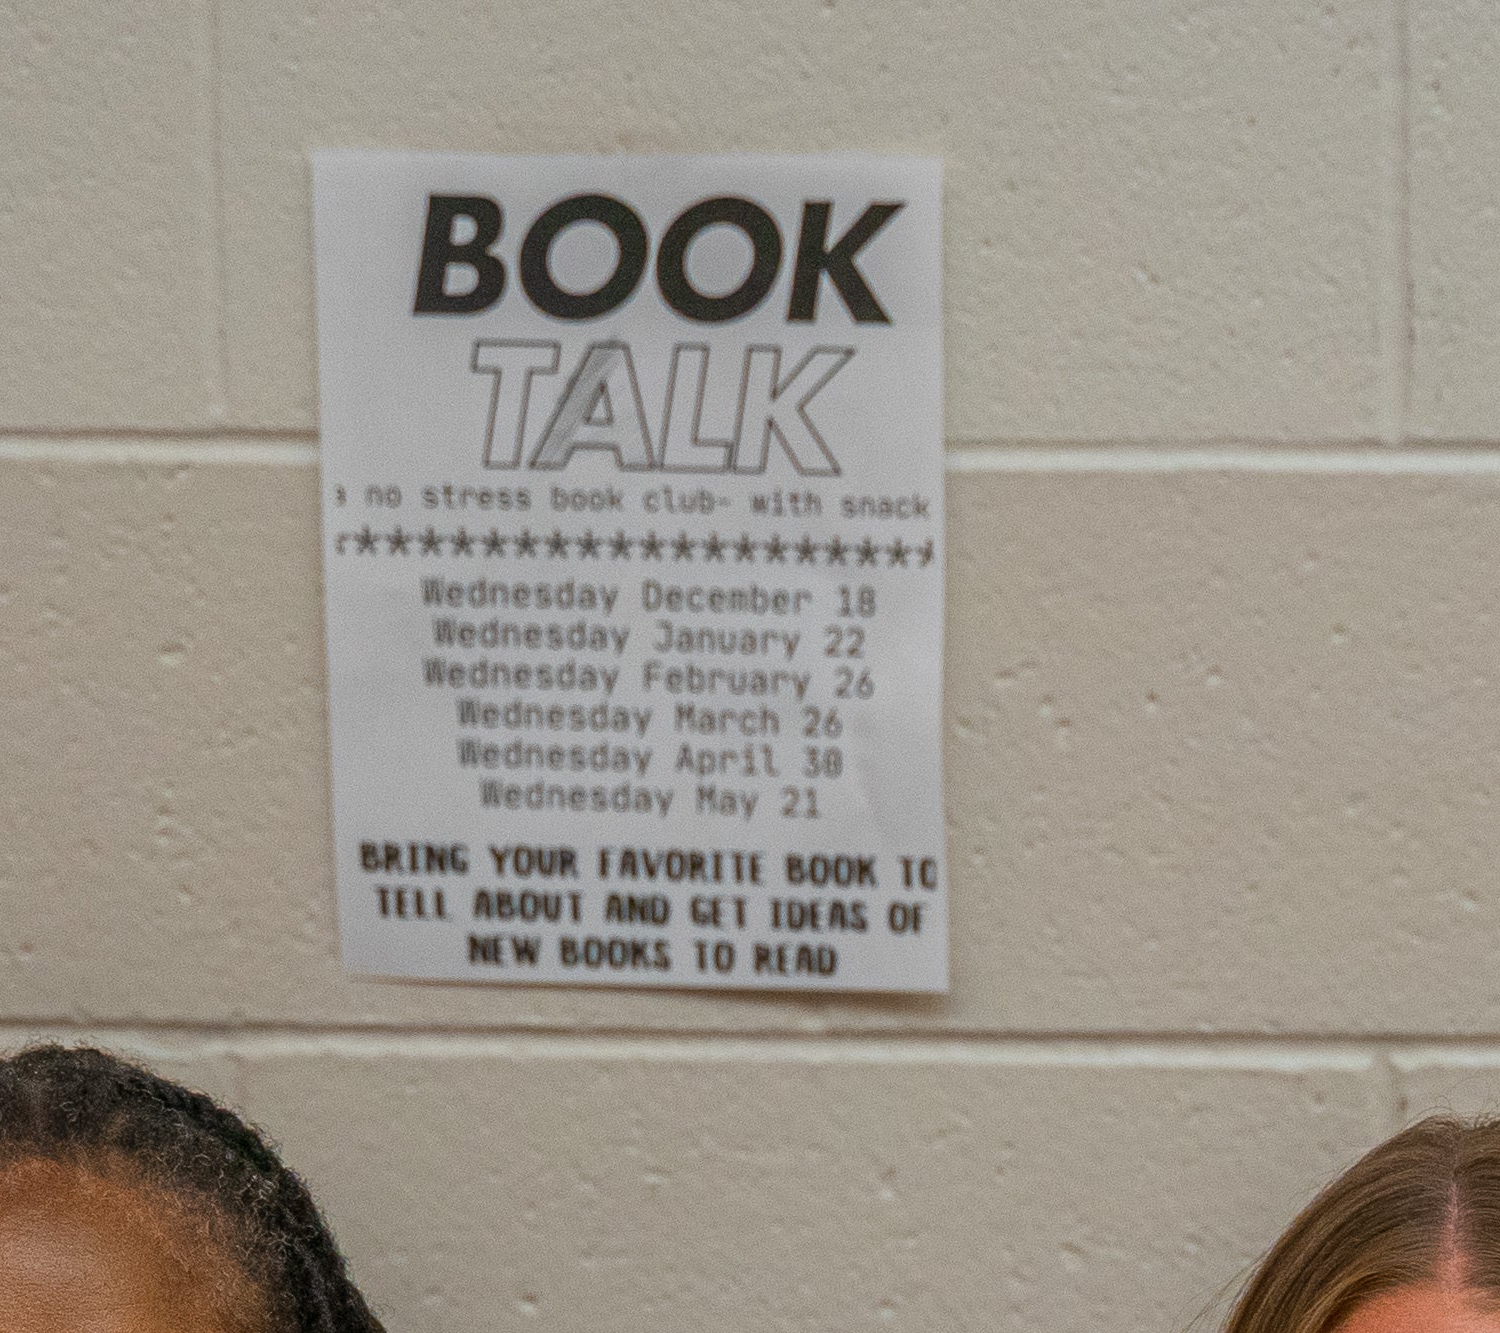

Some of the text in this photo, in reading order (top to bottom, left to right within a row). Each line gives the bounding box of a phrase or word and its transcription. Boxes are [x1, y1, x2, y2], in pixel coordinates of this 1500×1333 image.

[412, 192, 906, 326] BOOK
[470, 337, 857, 475] TALK
[364, 484, 401, 508] no
[421, 481, 531, 511] stress
[551, 484, 624, 513] book
[751, 488, 822, 517] with
[840, 492, 930, 520] snack
[421, 575, 878, 619] Wednesday December 18
[433, 618, 867, 661] Wednesday January 22
[423, 656, 875, 700] Wednesday February 26
[456, 697, 843, 739] Wednesday March 26
[457, 736, 843, 779] Wednesday April 30
[480, 777, 821, 820] Wednesday May 21
[359, 841, 469, 875] BRING
[489, 844, 578, 878] YOUR
[598, 847, 764, 886] FAVORITE
[785, 852, 878, 888] BOOK
[376, 886, 924, 935] TELL ABOUT AND GET IDEAS OF
[468, 932, 839, 977] NEW BOOKS TO READ
